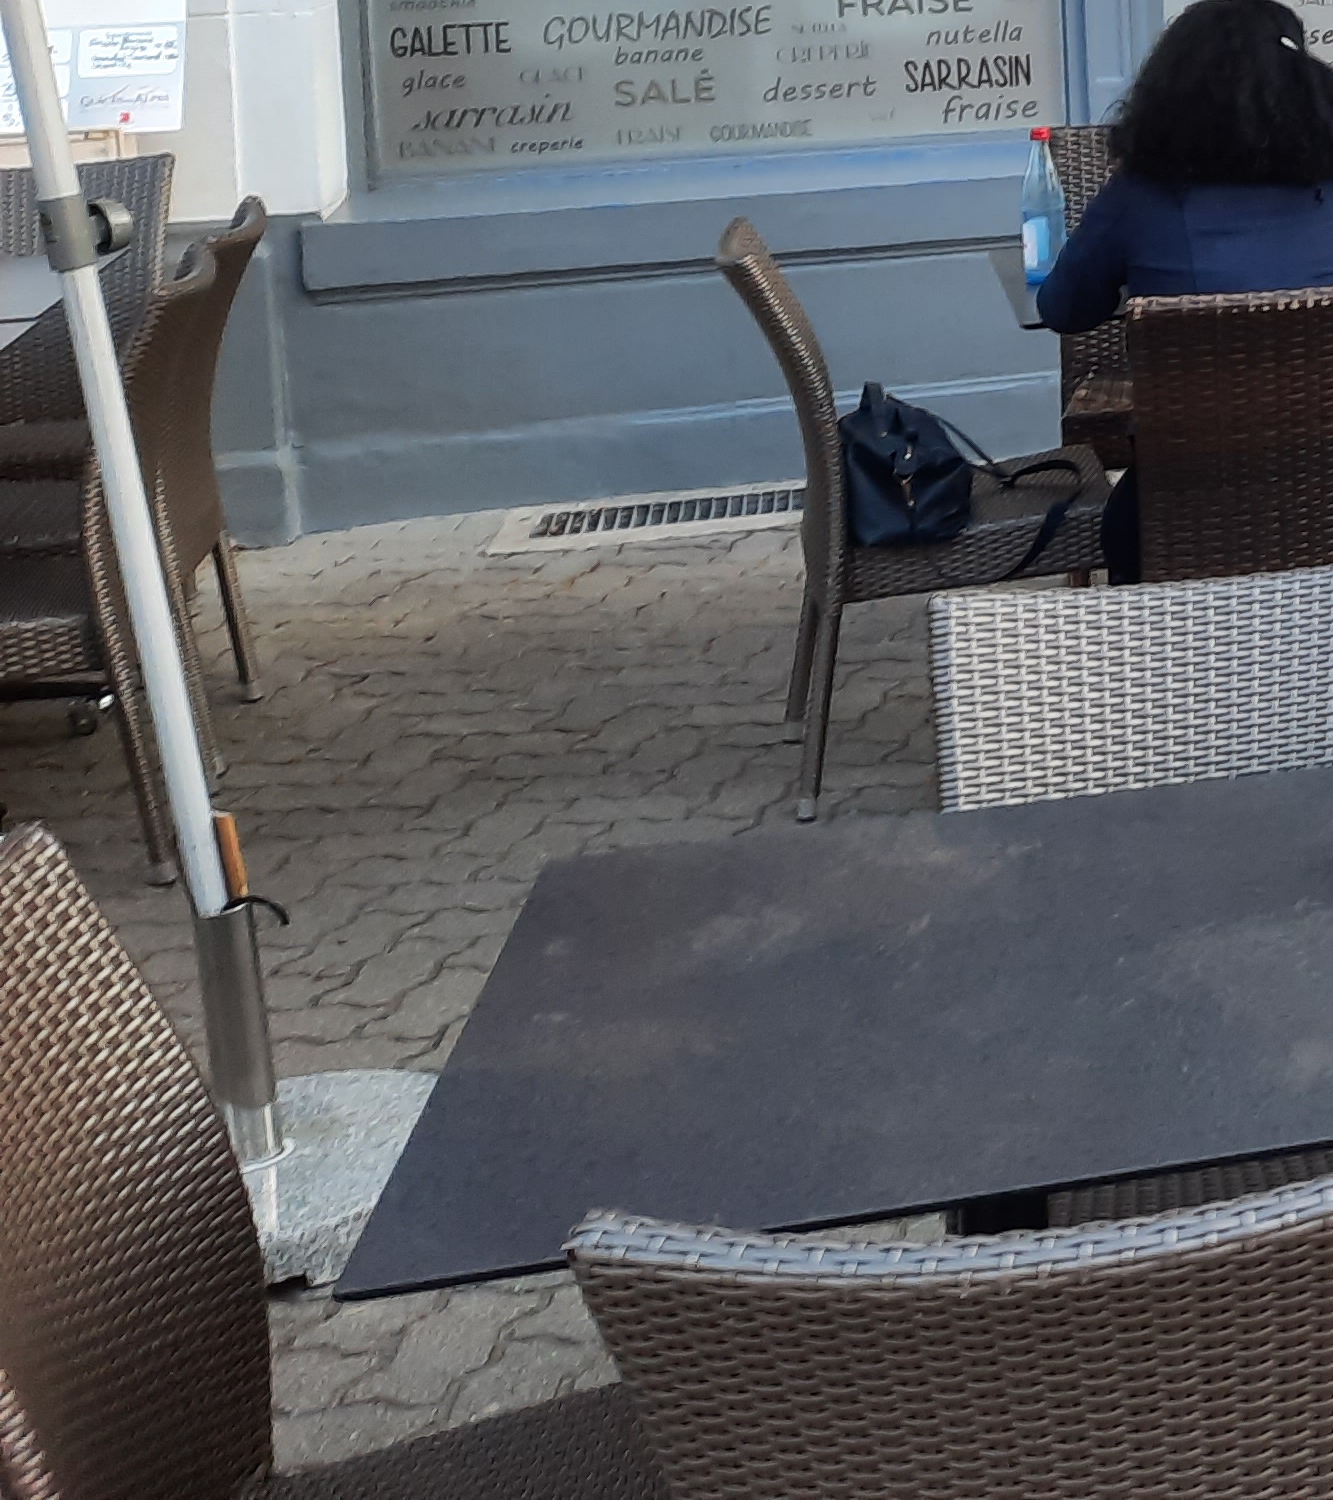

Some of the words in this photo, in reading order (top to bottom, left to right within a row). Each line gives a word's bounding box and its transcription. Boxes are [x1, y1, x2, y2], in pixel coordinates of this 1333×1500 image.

[390, 21, 513, 59] GALETTE
[543, 4, 773, 51] GOURMANDISE
[614, 46, 705, 67] banane
[926, 19, 1024, 47] nutella
[402, 69, 468, 98] glace
[614, 68, 716, 108] SALÉ
[763, 75, 877, 102] dessert
[904, 53, 1033, 95] SARRASIN
[942, 95, 1039, 125] fraise
[510, 137, 584, 155] creperie
